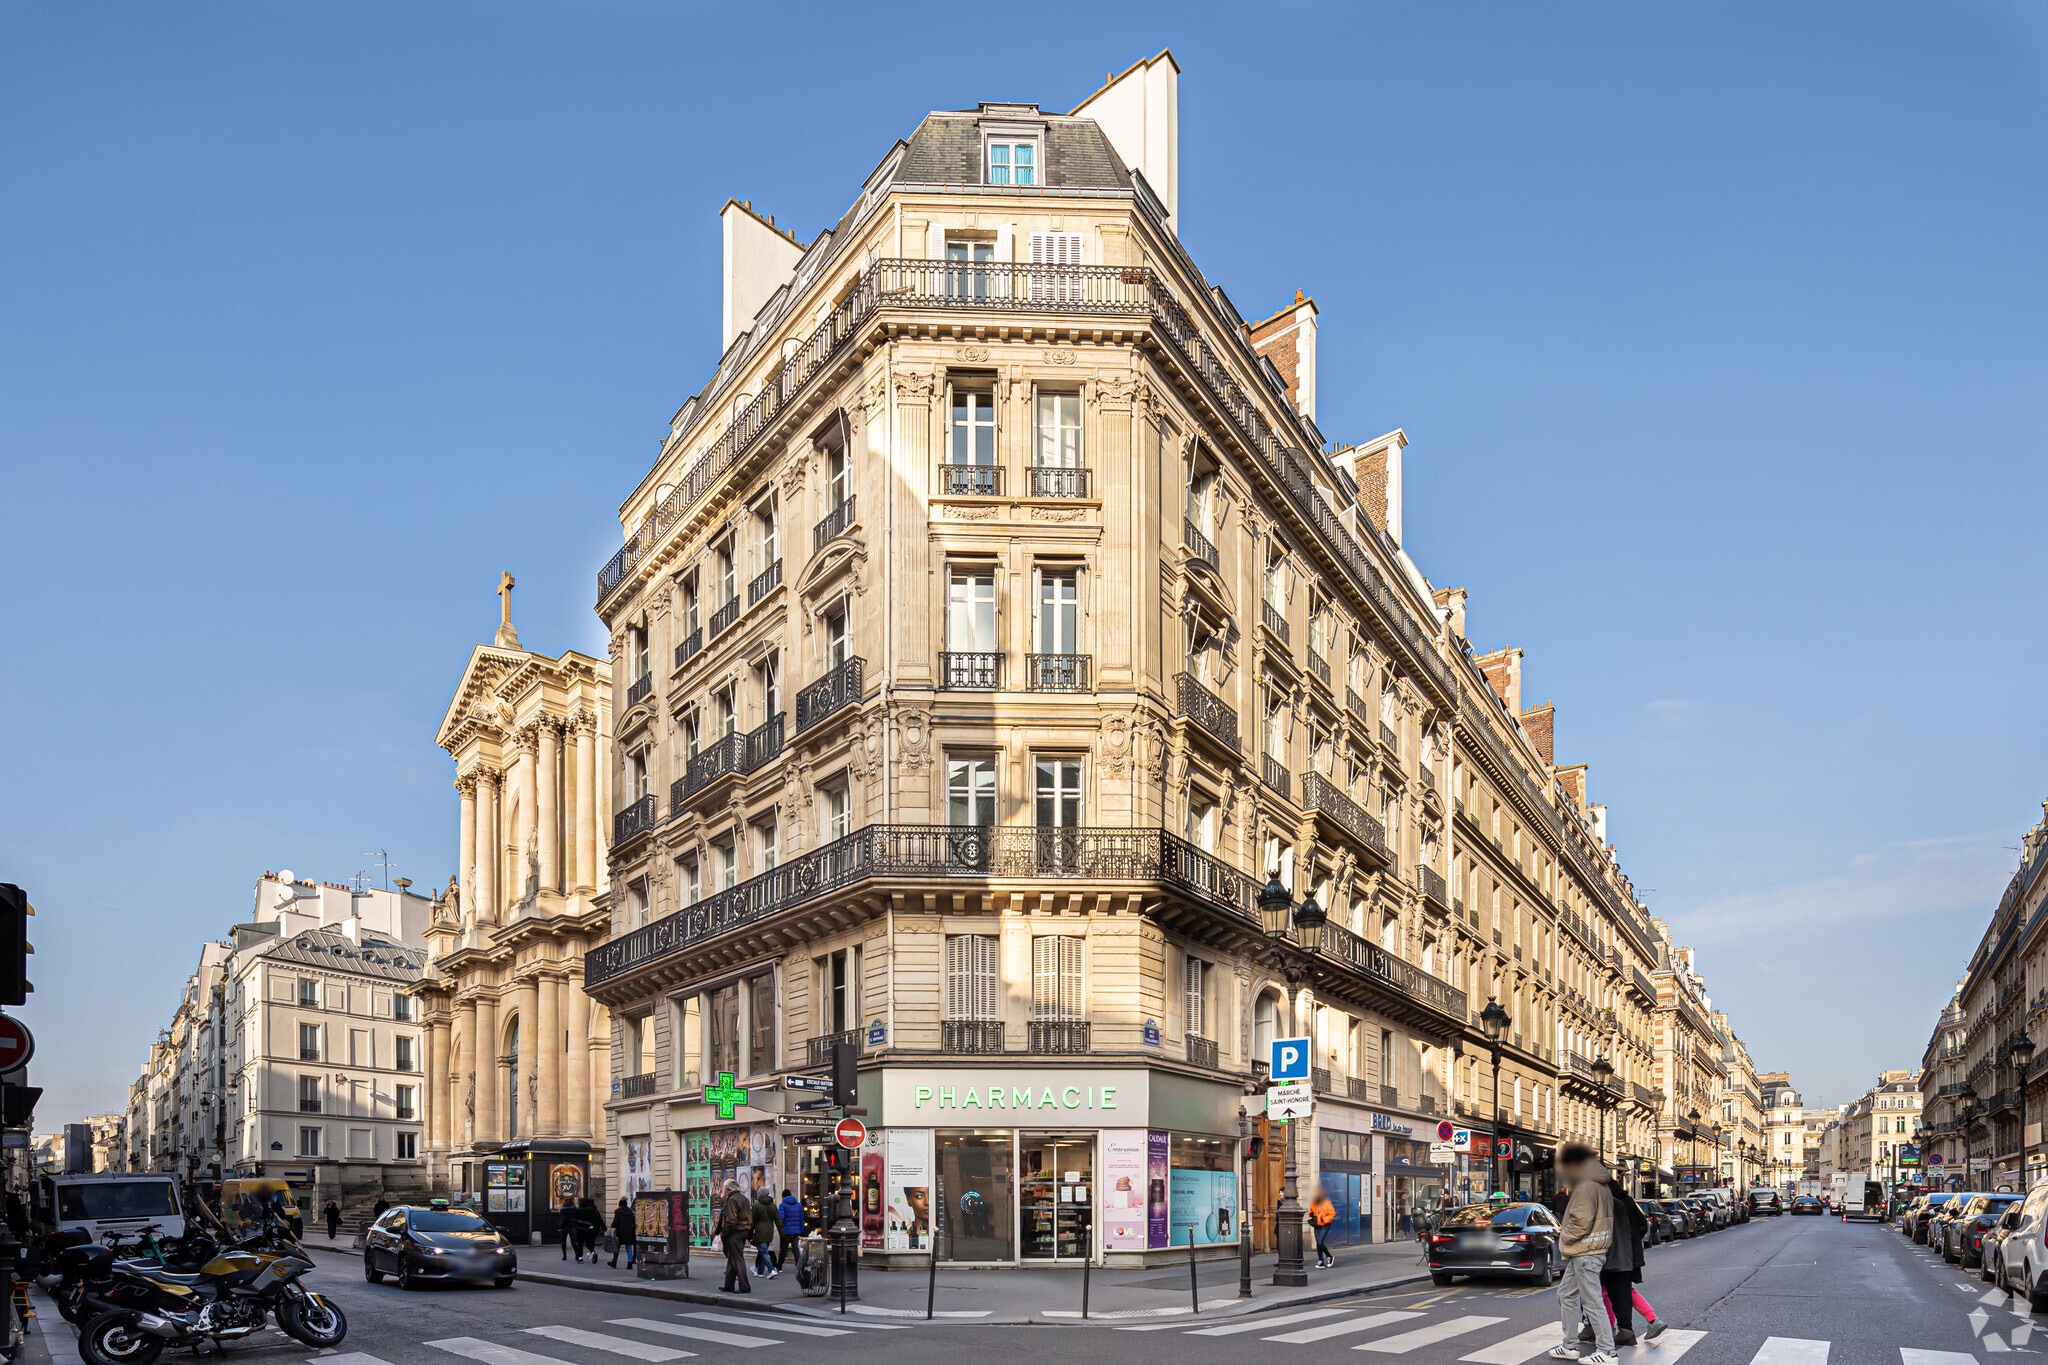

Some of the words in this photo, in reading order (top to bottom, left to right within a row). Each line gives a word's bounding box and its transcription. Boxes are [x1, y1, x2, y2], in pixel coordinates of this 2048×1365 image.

[1281, 1046, 1299, 1073] P
[915, 1085, 1118, 1109] PHARMACIE
[1270, 1095, 1309, 1106] SAINT-HONORÉ
[1277, 1088, 1301, 1097] MARCHÉ
[1371, 1112, 1392, 1130] BRED
